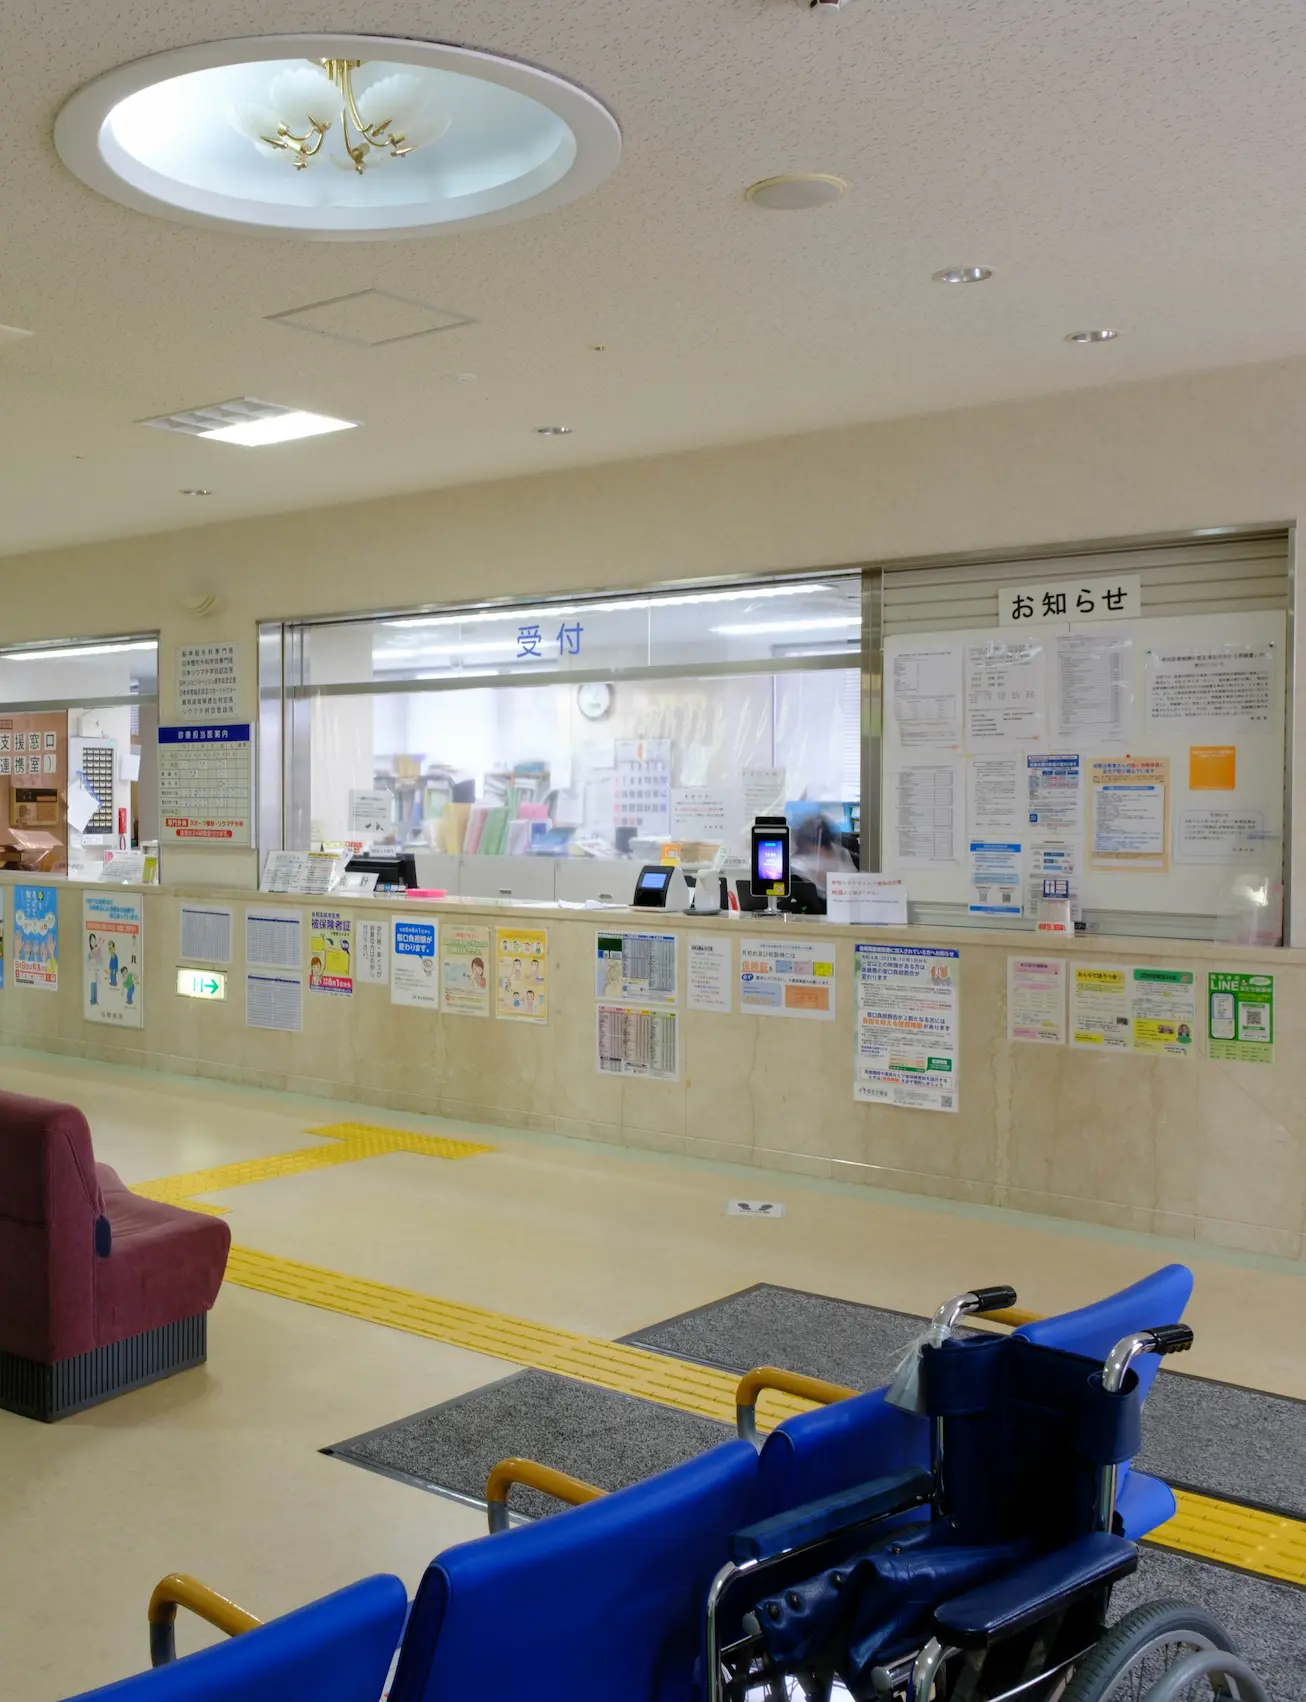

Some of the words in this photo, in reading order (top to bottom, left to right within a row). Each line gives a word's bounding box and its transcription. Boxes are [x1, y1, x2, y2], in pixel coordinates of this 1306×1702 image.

[1012, 587, 1127, 619] お知らせ
[517, 622, 584, 657] 受付
[178, 730, 229, 740] 診療担当医案内
[0, 733, 54, 750] 支援窓口
[311, 919, 351, 931] 被保険者証
[398, 943, 430, 953] 変わります。
[1211, 981, 1239, 991] LINE
